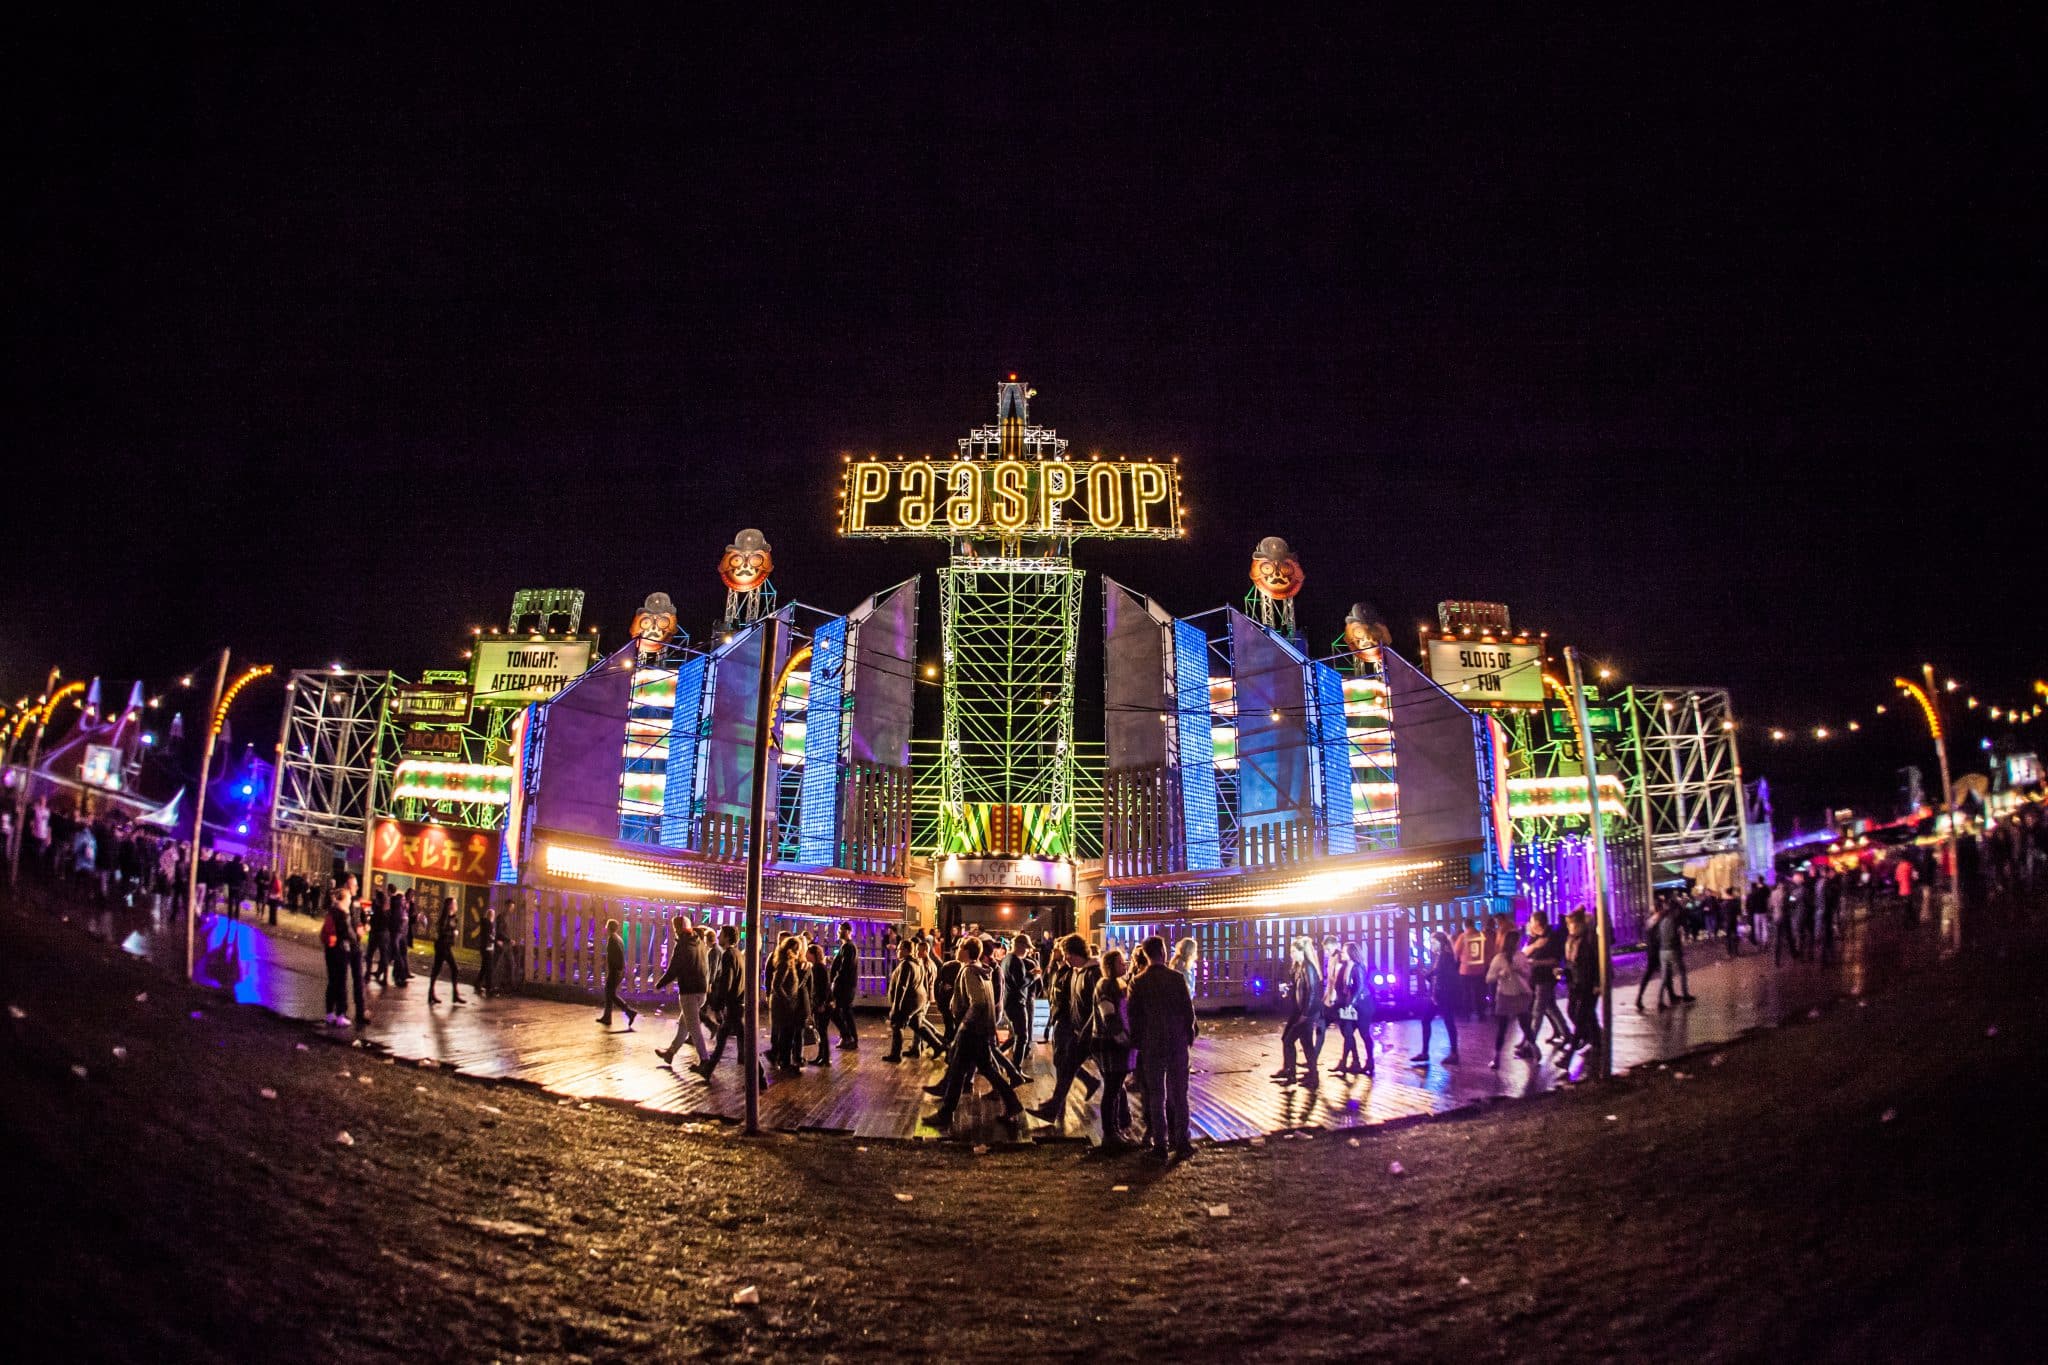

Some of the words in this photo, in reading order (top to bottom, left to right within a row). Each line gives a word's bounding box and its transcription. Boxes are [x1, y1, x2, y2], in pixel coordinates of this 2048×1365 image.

[507, 651, 558, 668] TONIGHT:
[1460, 651, 1496, 669] SLOTS
[1497, 652, 1511, 669] OF
[1478, 674, 1501, 691] FUN
[406, 732, 460, 749] ARCADE
[1015, 874, 1042, 886] MINA
[1470, 941, 1480, 958] 9
